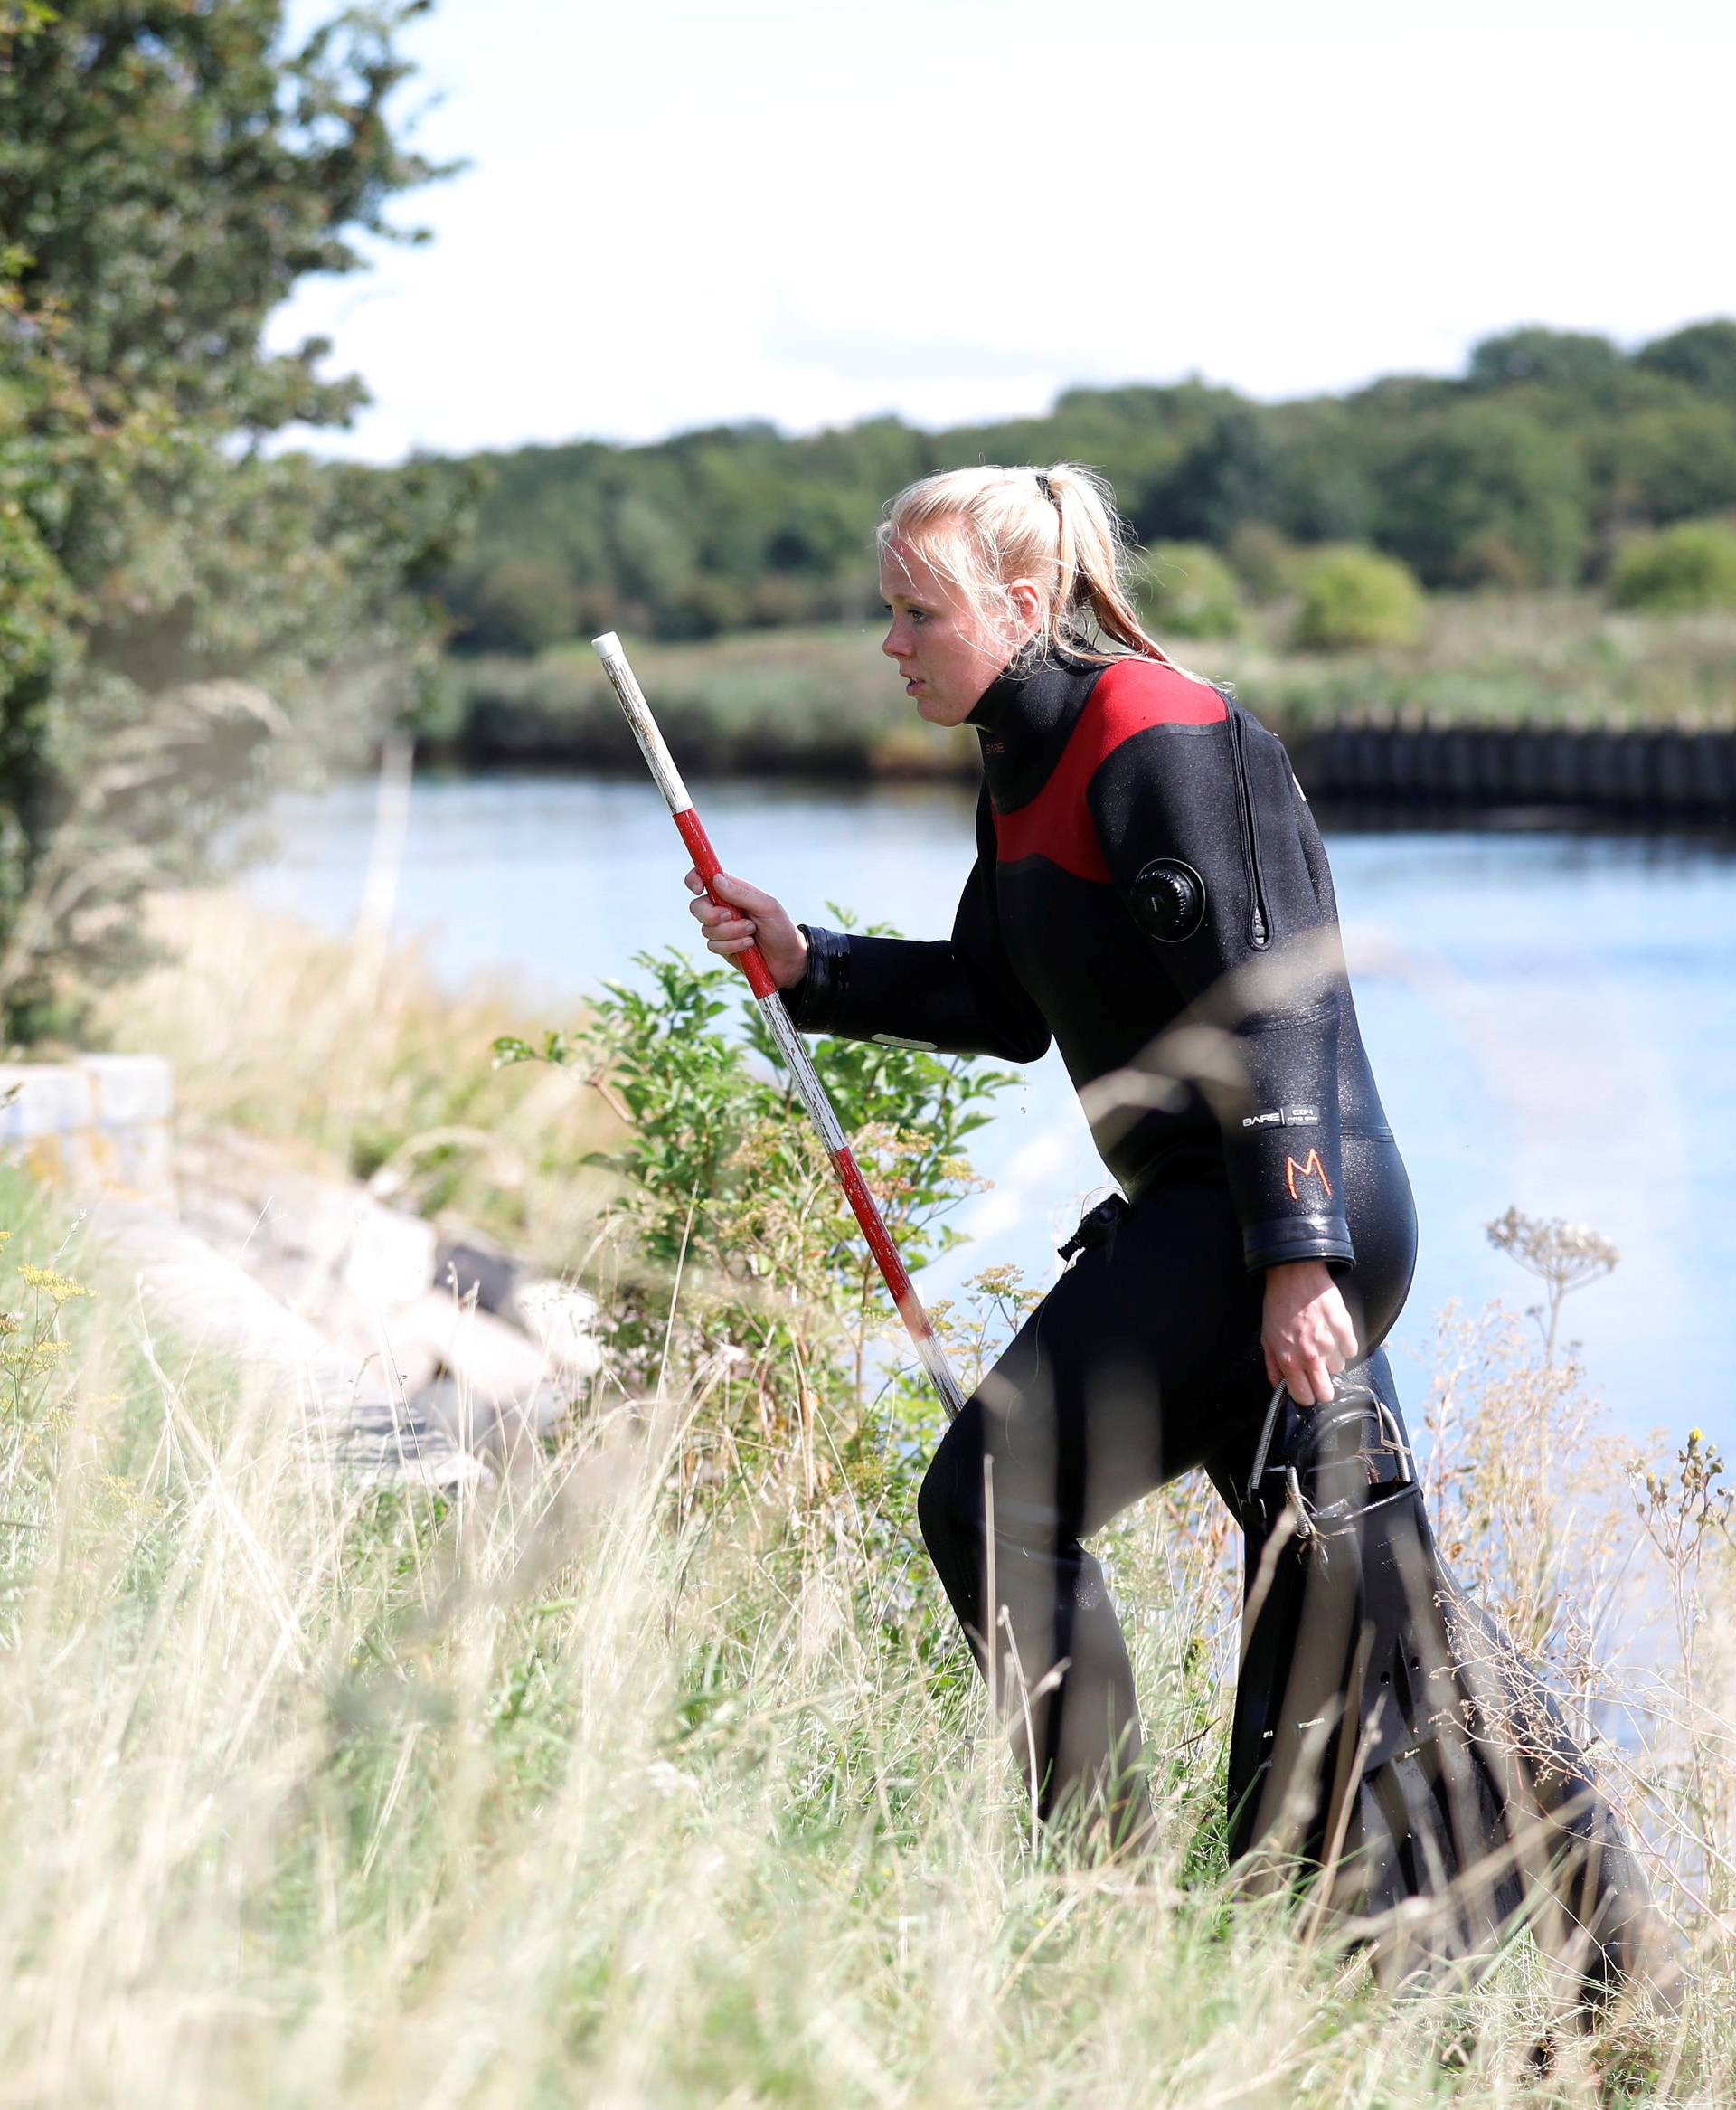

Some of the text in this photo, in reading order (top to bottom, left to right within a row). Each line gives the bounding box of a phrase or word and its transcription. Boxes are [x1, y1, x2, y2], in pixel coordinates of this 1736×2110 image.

[985, 742, 1005, 754] BARE
[1242, 1112, 1280, 1127] BARE
[1286, 1148, 1334, 1200] M
